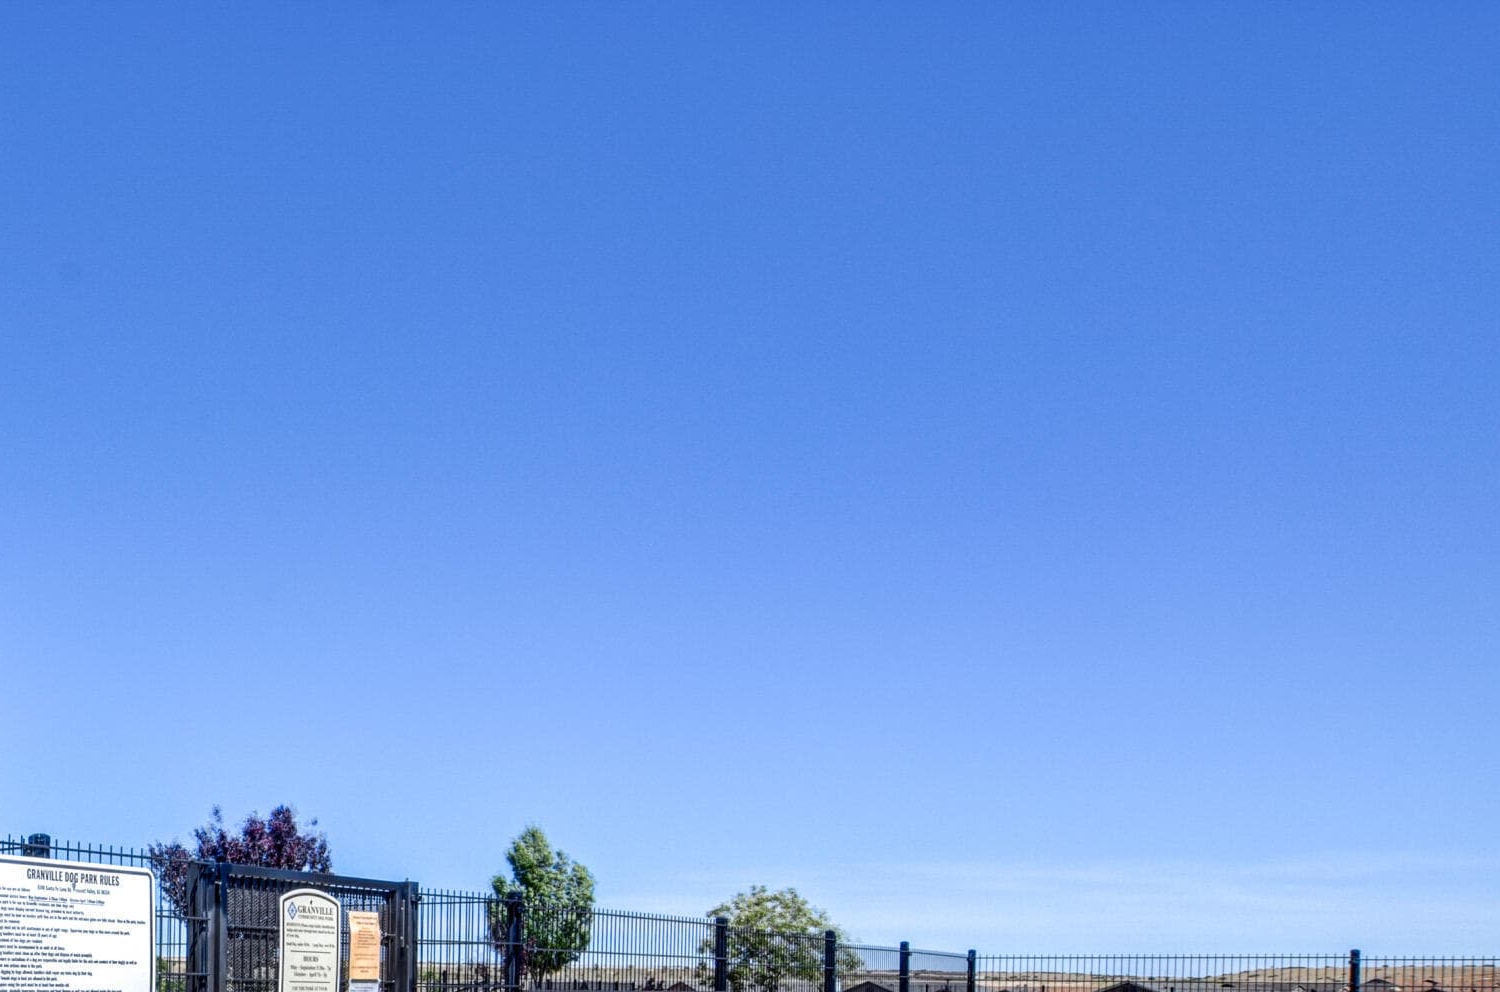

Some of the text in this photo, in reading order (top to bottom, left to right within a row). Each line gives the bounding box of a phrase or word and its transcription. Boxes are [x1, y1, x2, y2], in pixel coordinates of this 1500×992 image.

[26, 868, 120, 886] GRANVILLE DOG PARK RULES
[298, 905, 333, 915] GRANVILLE
